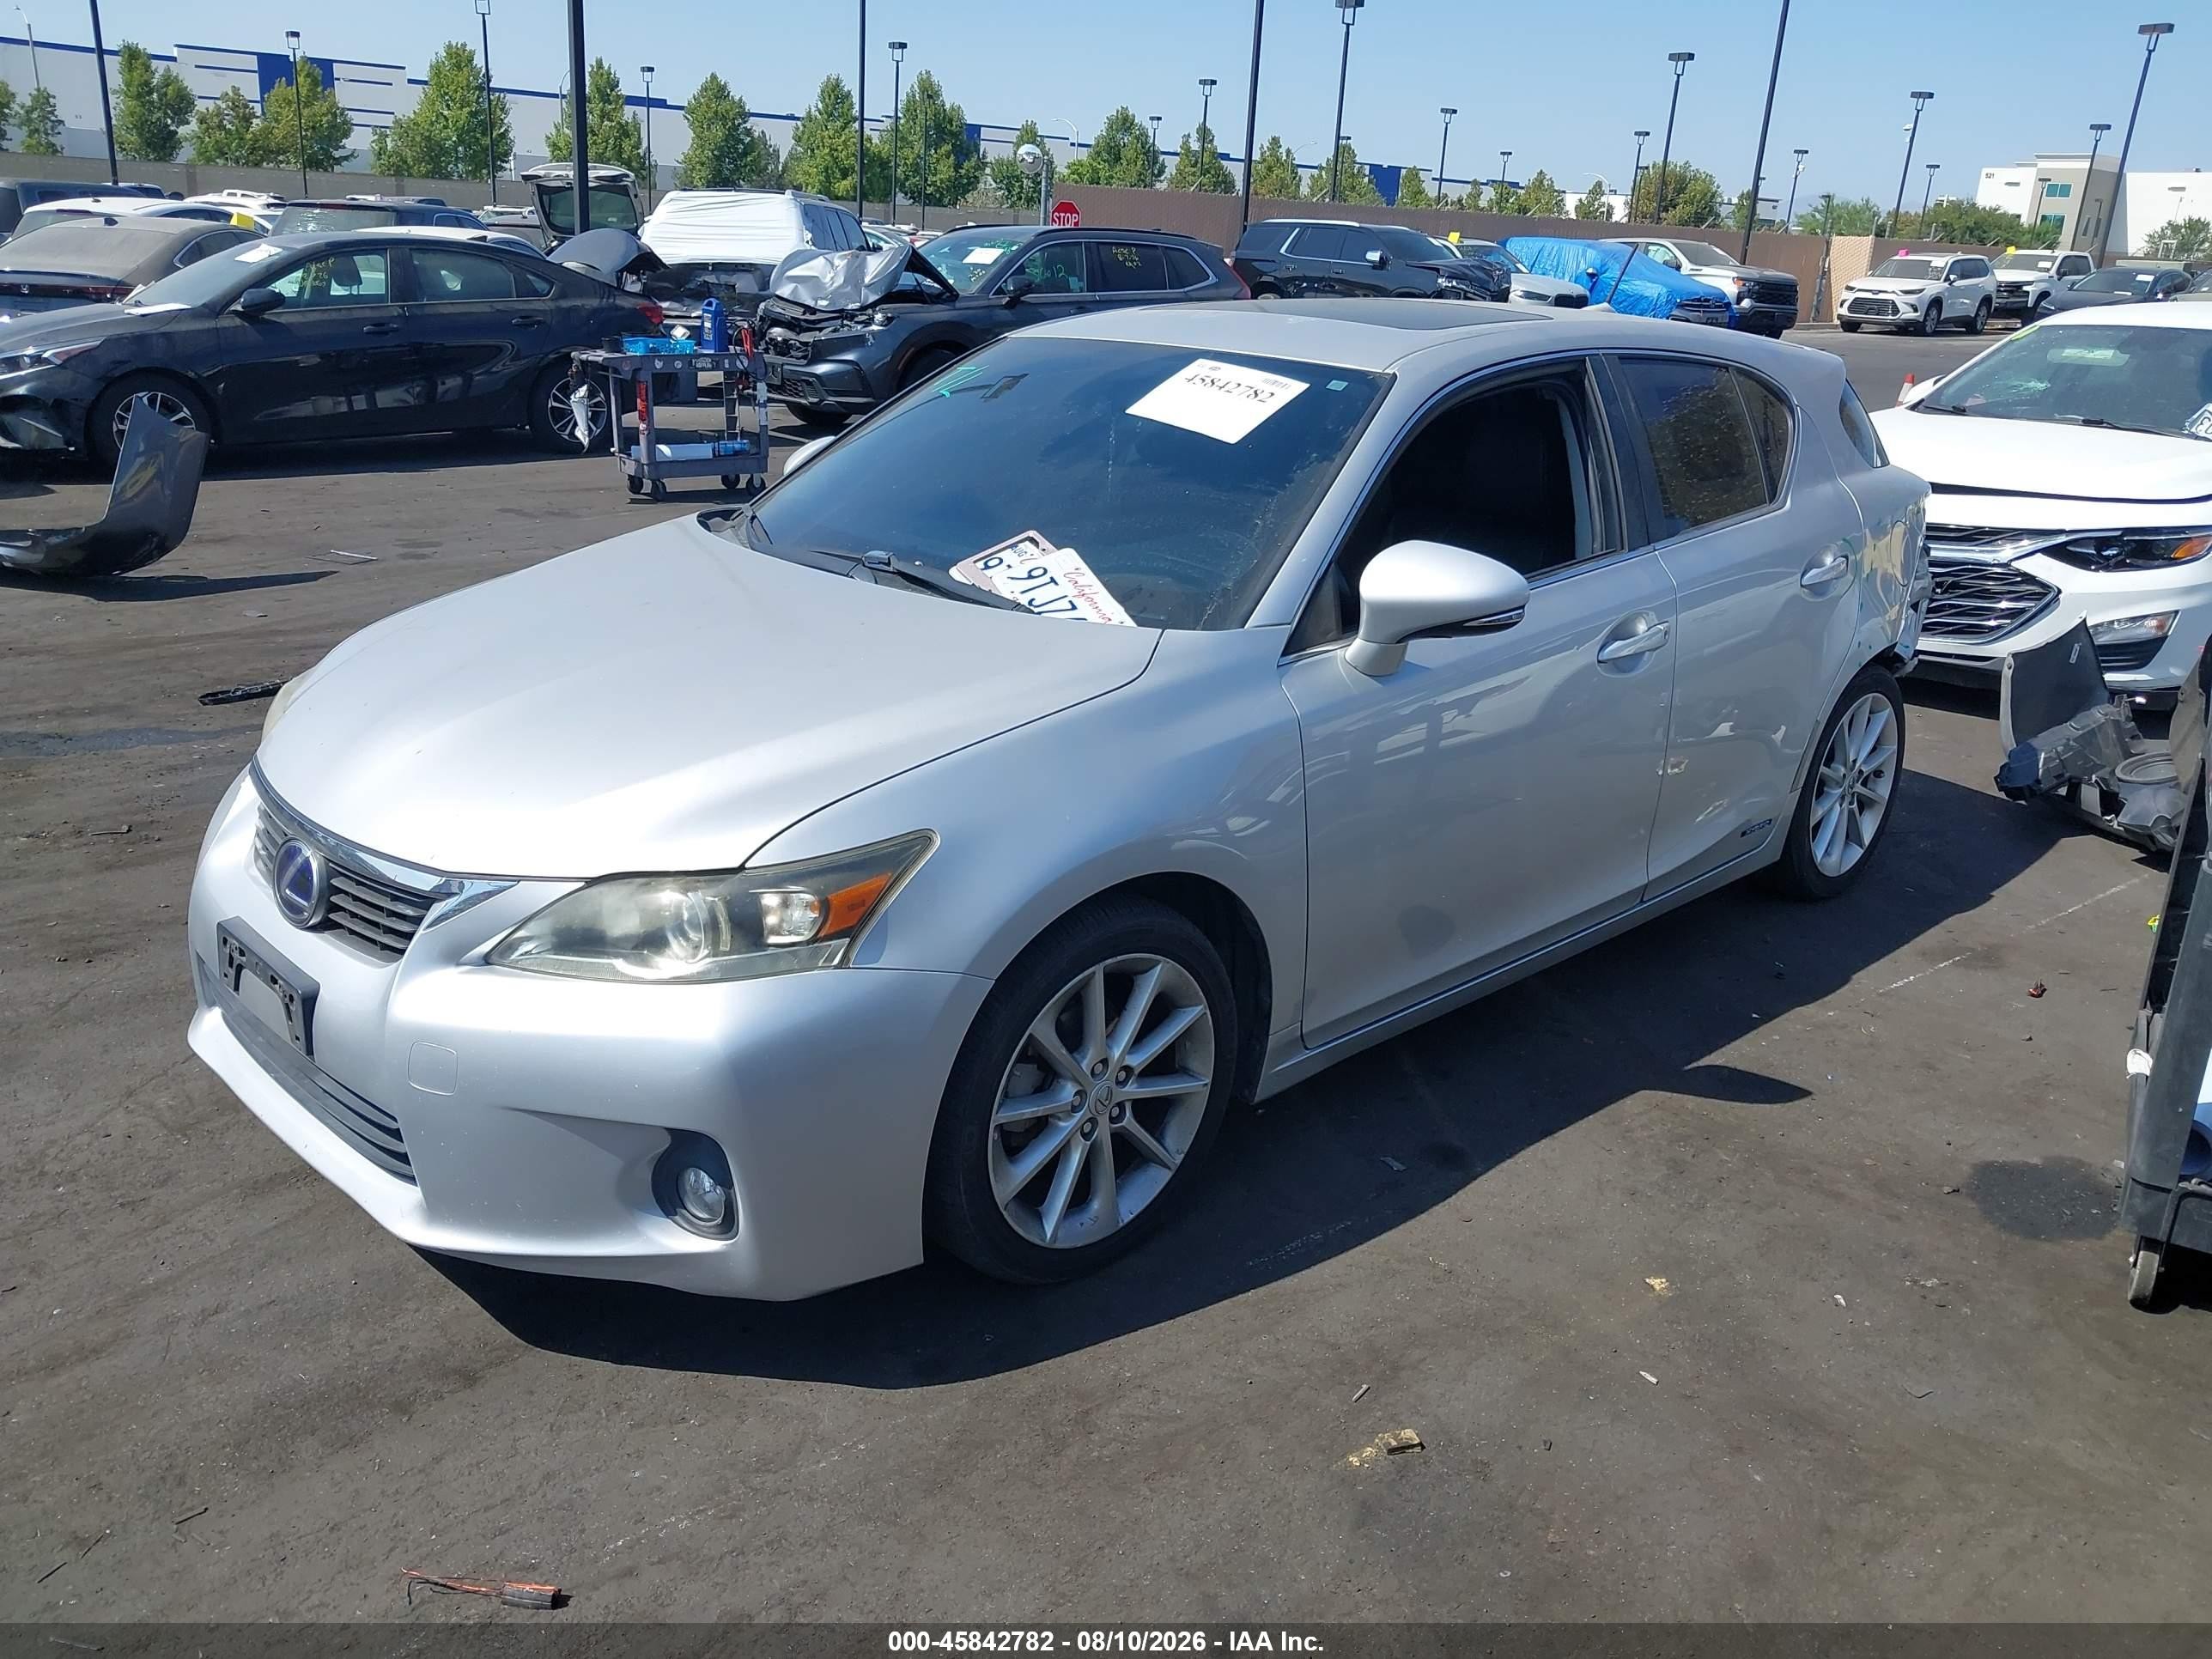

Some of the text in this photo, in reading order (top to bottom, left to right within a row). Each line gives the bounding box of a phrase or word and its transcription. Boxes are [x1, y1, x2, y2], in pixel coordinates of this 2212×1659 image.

[1052, 211, 1079, 227] STOP
[1184, 373, 1276, 404] 45842782
[1006, 566, 1088, 621] 9TJ7
[1063, 568, 1113, 624] California
